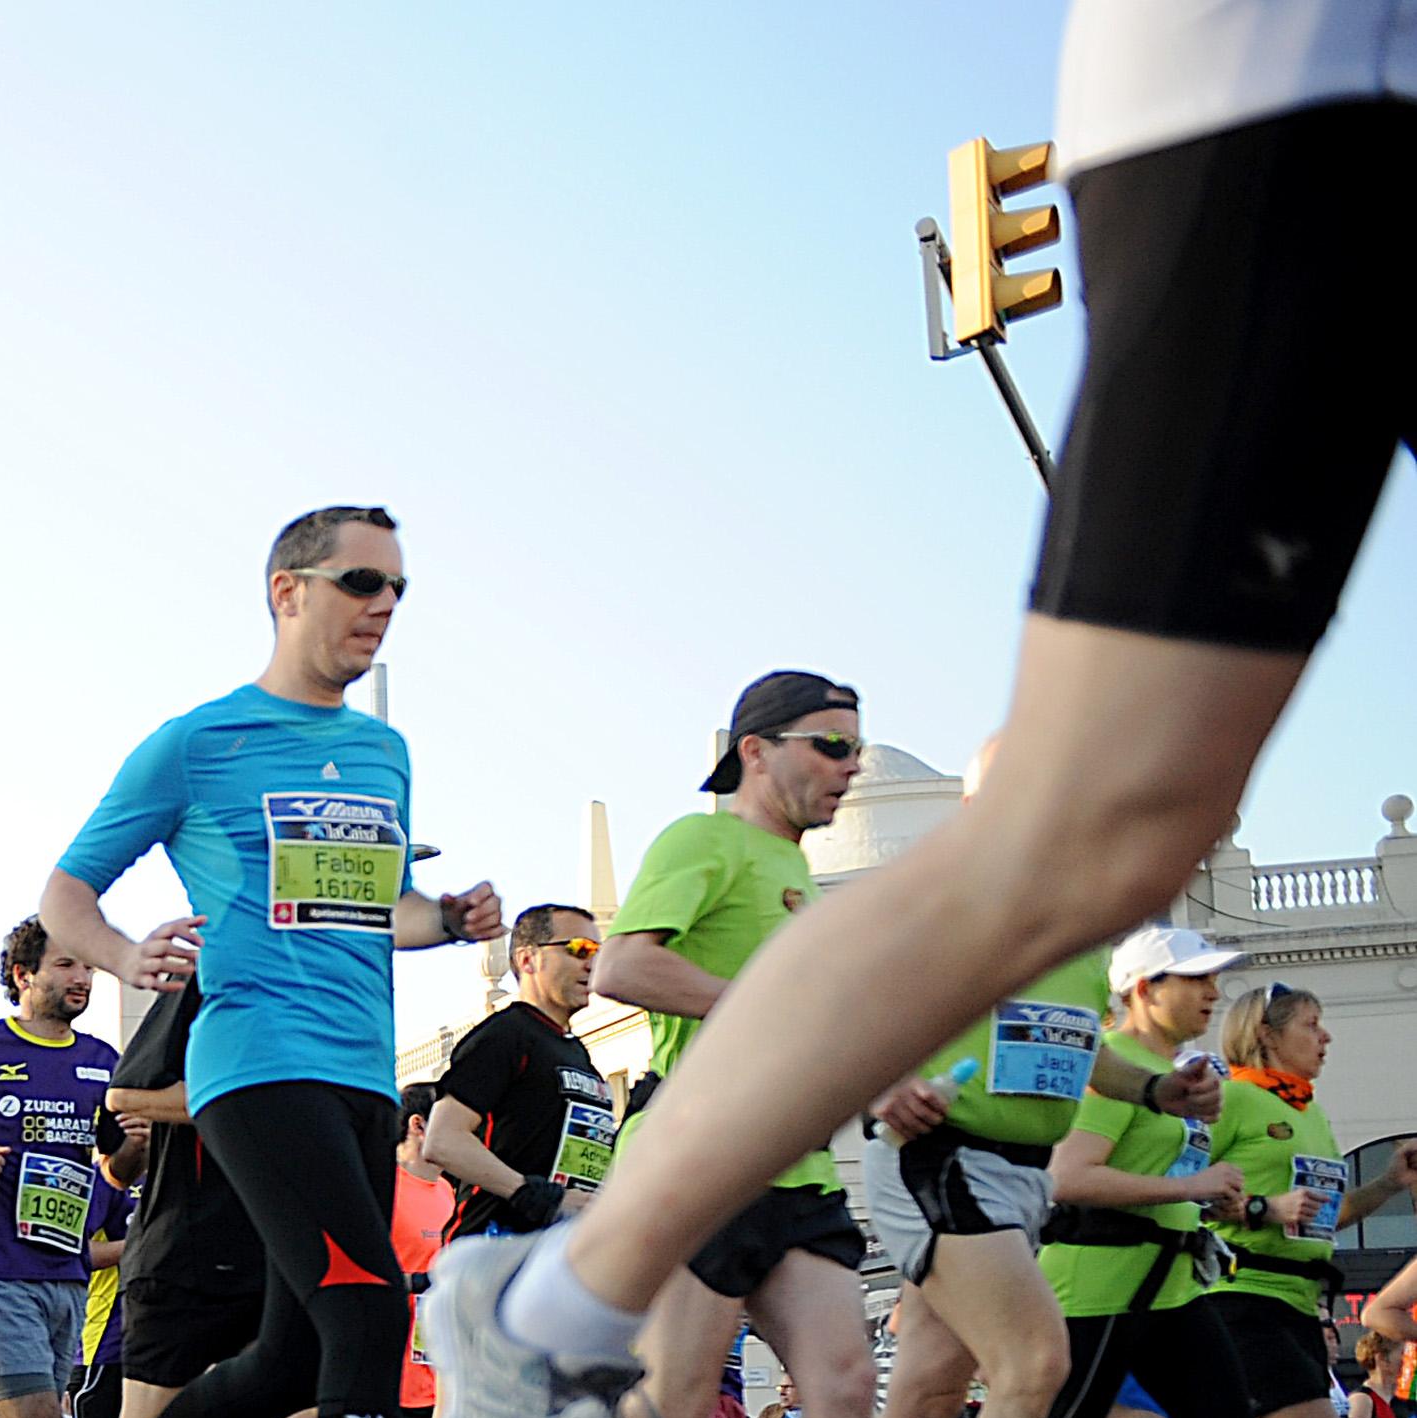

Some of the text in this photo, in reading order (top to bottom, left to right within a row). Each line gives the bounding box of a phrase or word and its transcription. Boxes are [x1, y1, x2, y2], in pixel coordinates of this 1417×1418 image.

[315, 852, 375, 875] Fabio
[314, 878, 376, 901] 16176
[1036, 1053, 1077, 1074] Jack
[23, 1099, 75, 1114] ZURICH
[31, 1194, 84, 1229] 19587
